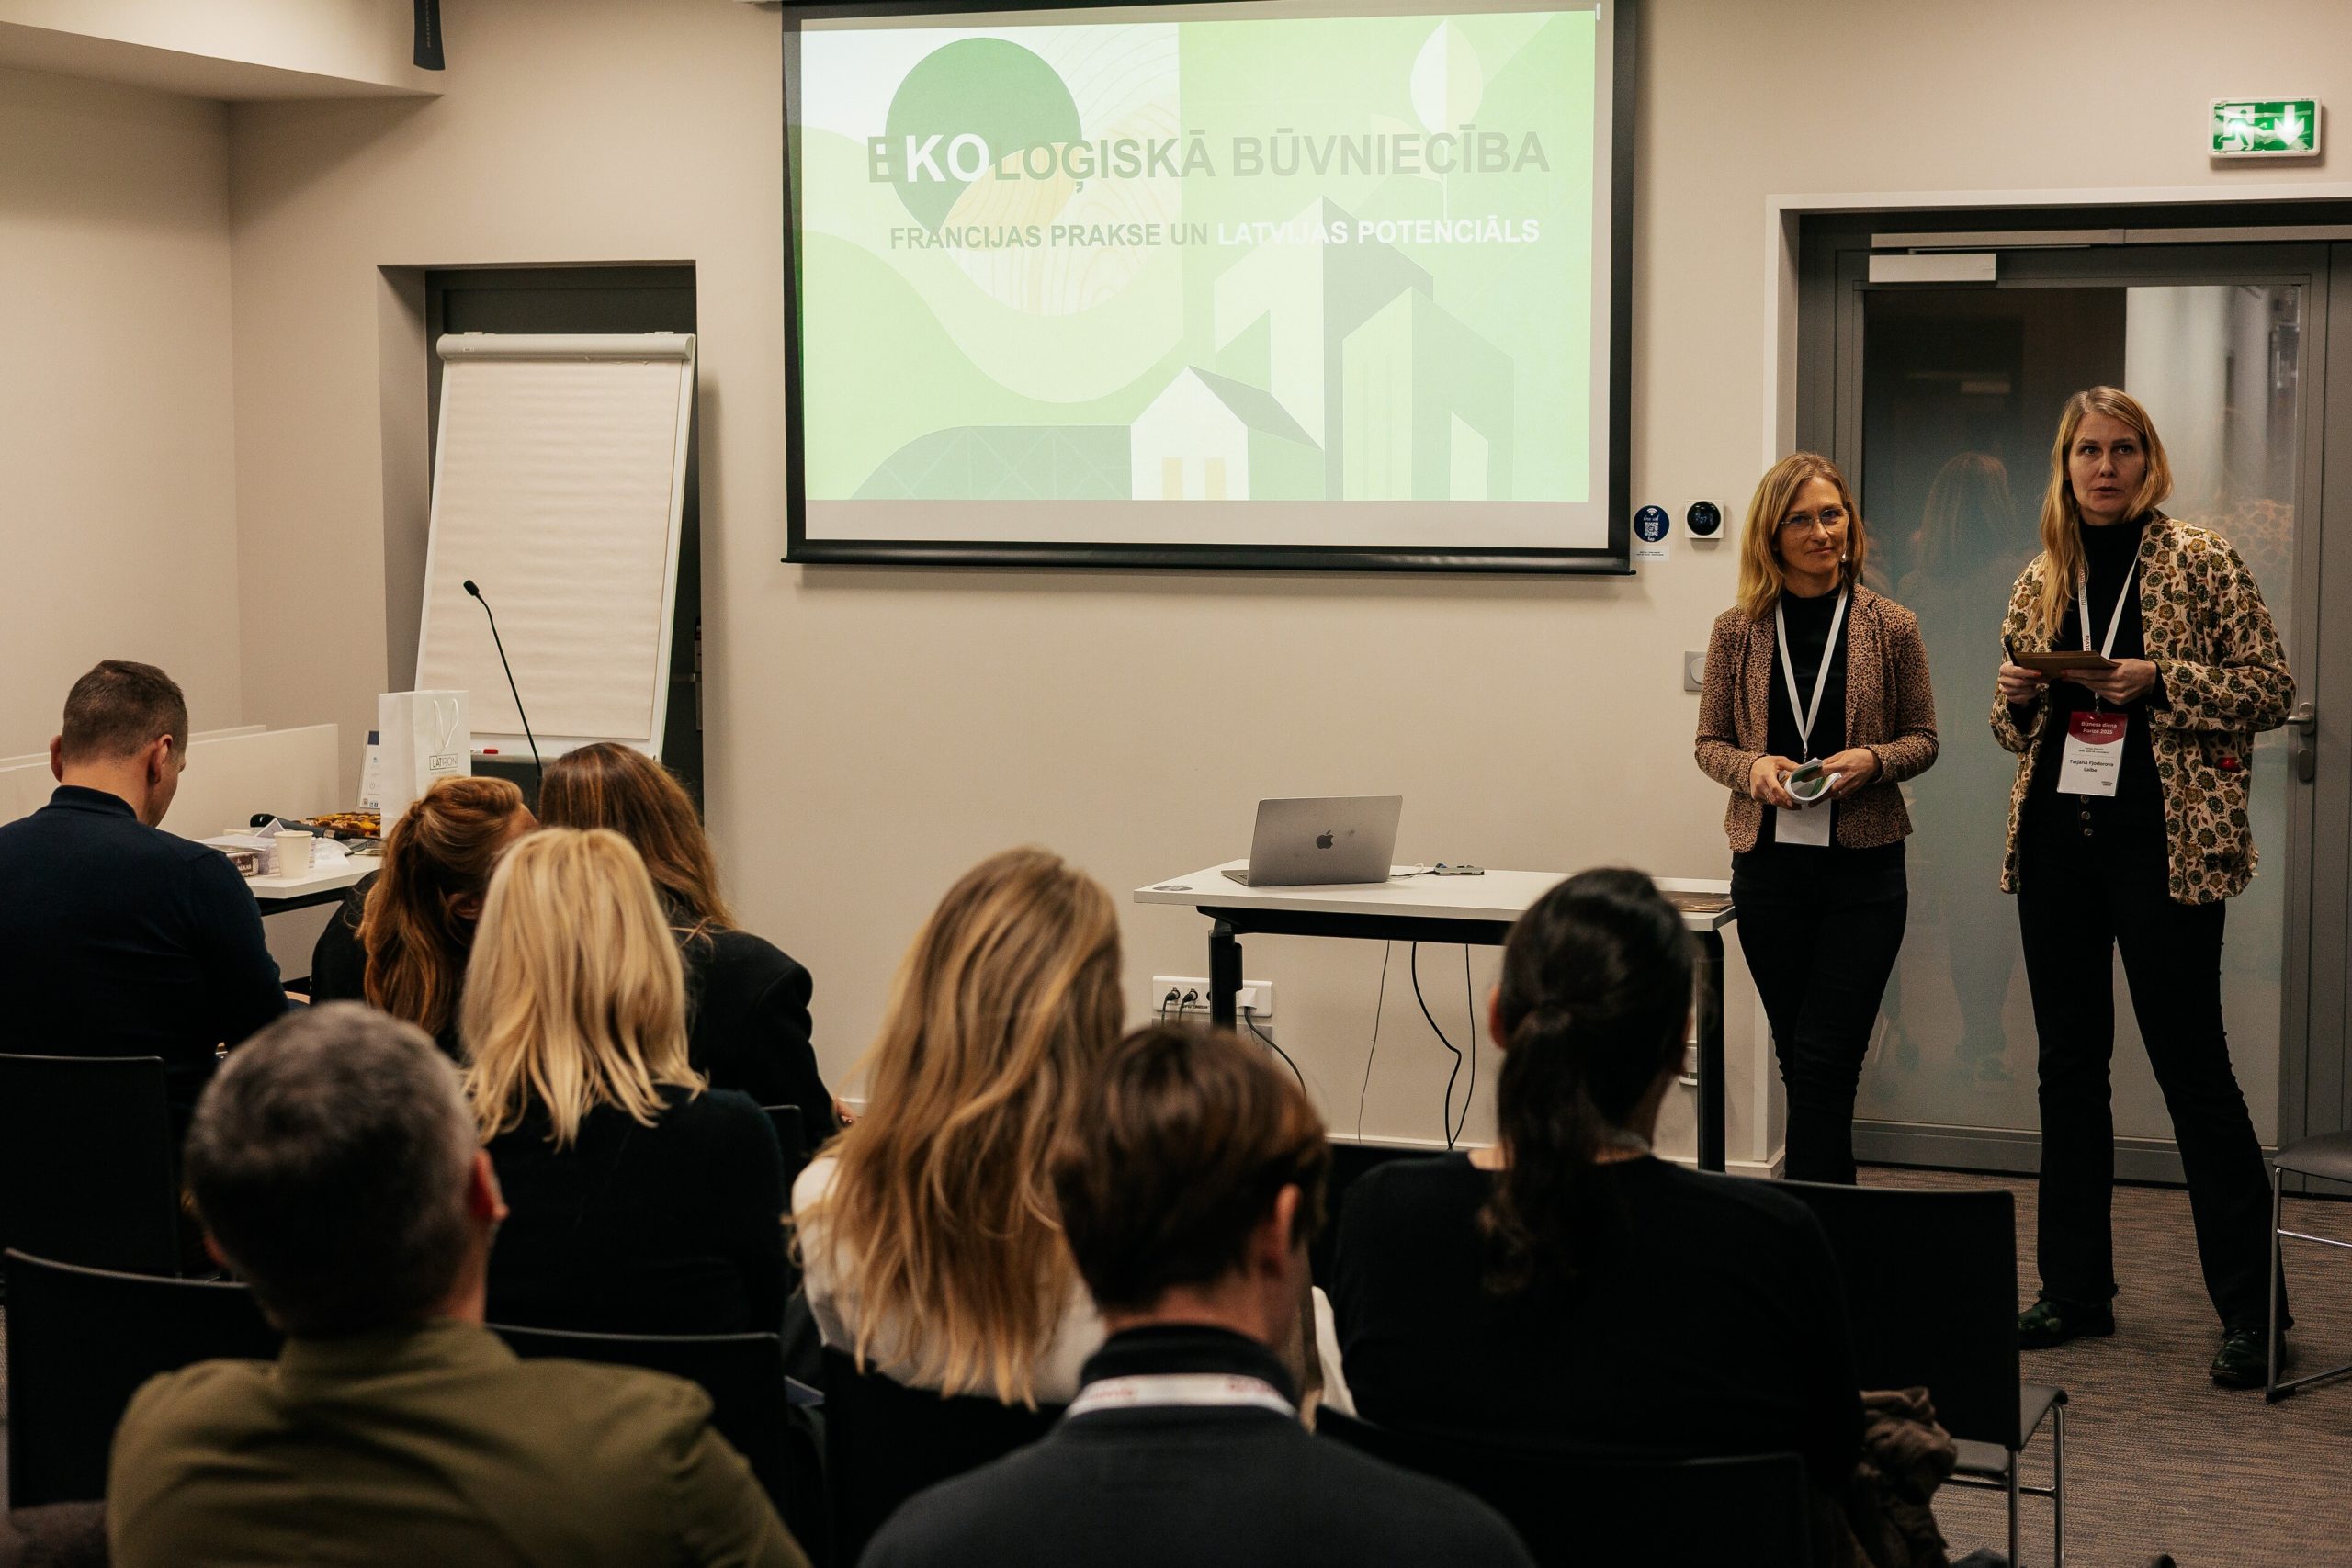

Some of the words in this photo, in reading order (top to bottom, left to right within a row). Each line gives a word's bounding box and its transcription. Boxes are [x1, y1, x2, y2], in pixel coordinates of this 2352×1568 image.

[868, 130, 1216, 193] EKOLOĢISKĀ
[1233, 124, 1551, 176] BŪVNIECĪBA
[890, 225, 1042, 250] FRANCIJAS
[1051, 223, 1161, 247] PRAKSE
[1170, 223, 1207, 246] UN
[1217, 220, 1348, 246] LATVIJAS
[1358, 215, 1540, 244] POTENCIĀLS
